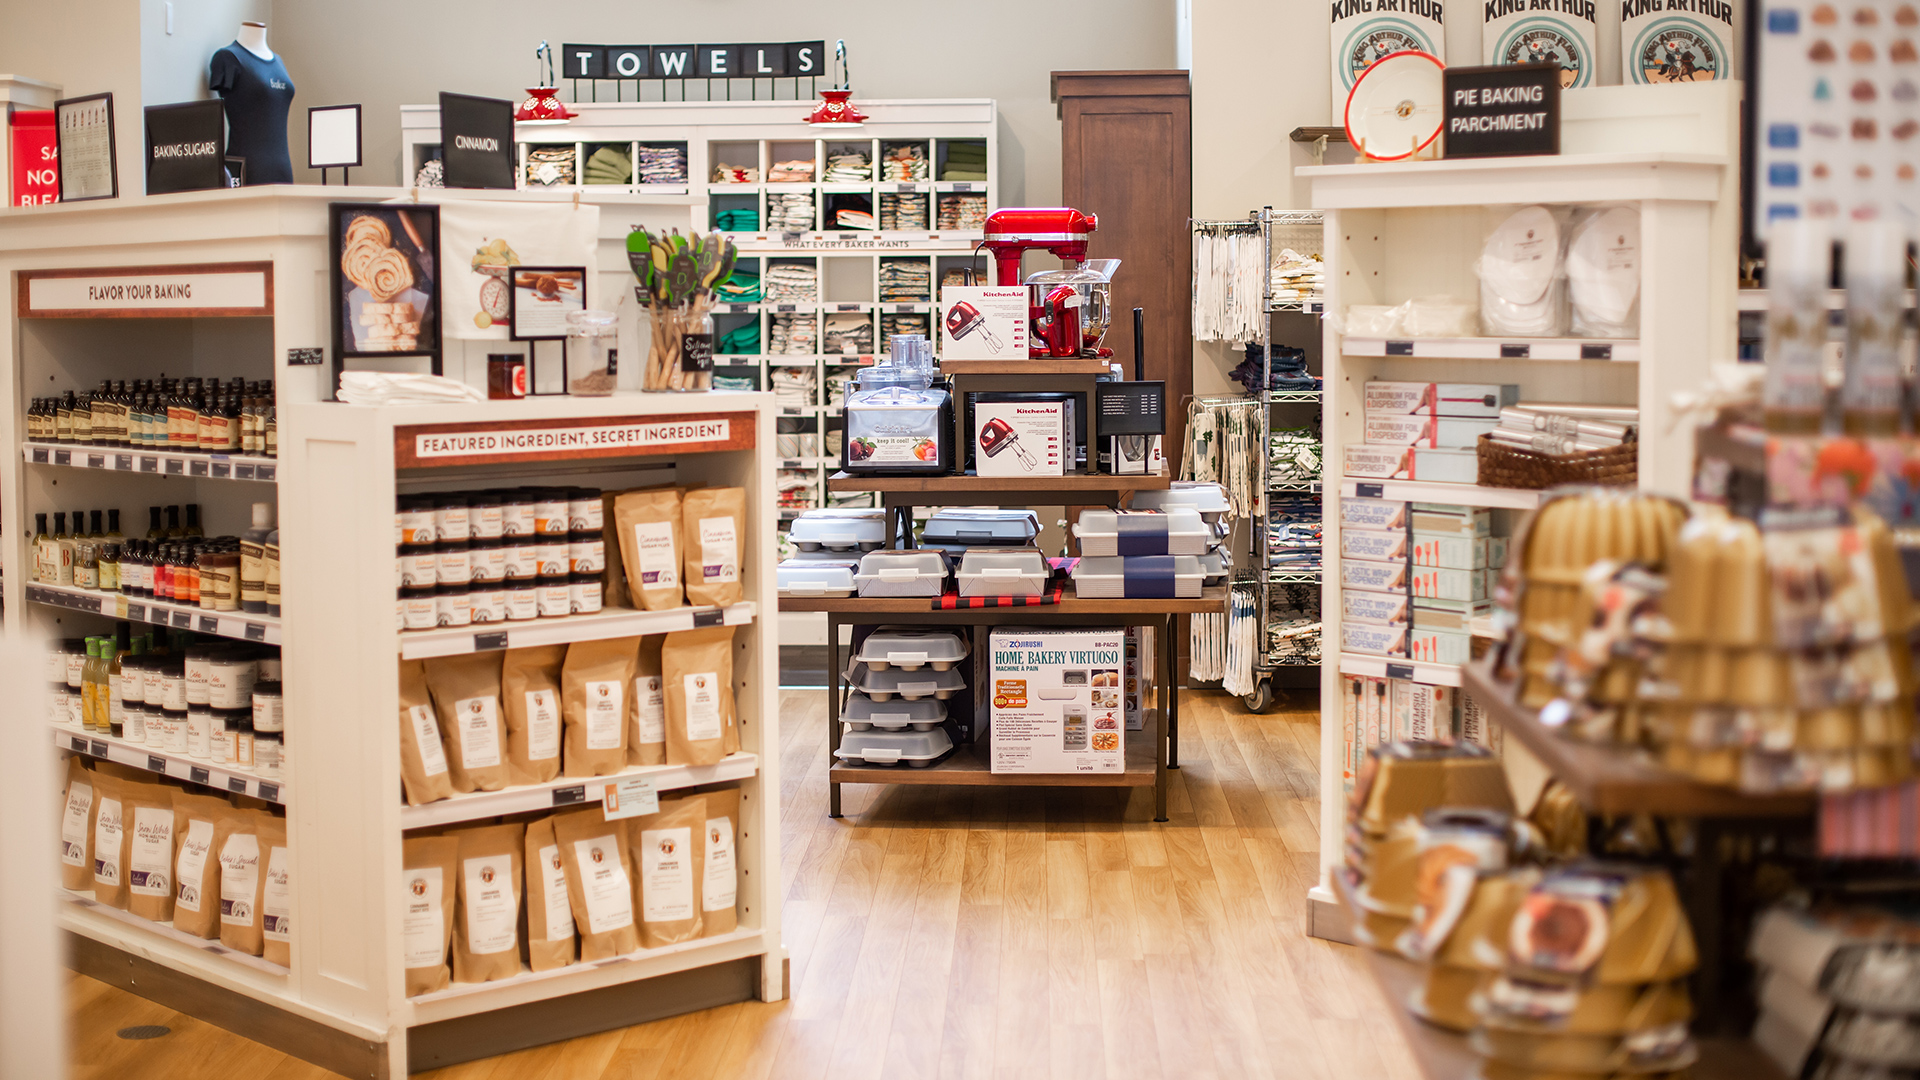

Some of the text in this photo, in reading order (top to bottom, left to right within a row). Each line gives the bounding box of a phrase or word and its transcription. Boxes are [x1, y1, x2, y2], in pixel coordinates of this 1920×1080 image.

[1332, 0, 1442, 25] KING ARTHUR
[1486, 0, 1596, 24] KING ARTHUR
[1622, 0, 1732, 26] KING ARTHUR
[1354, 41, 1369, 62] KING
[1369, 32, 1404, 45] ARTHUR
[1508, 31, 1578, 62] KING ARTHUR FLOUR
[1644, 31, 1714, 62] KING ARTHUR FLOUR
[575, 47, 814, 78] TOWELS
[1454, 86, 1544, 106] PIE BAKING
[1452, 112, 1547, 132] PARCHMENT
[154, 141, 216, 158] BAKING SUGARS
[455, 135, 498, 152] CINNAMON
[89, 284, 191, 300] FLAVOR YOUR BAKING
[1404, 392, 1419, 400] FOIL
[1372, 400, 1408, 408] DISPENSER
[1368, 422, 1419, 432] ALUMINUM FOIL
[424, 424, 722, 452] FEATURED INGREDIENT, SECRET INGREDIENT
[1372, 431, 1408, 440] DISPENSER
[1346, 454, 1397, 464] ALUMINUM FOIL
[1351, 463, 1386, 472] DISPENSER
[1341, 504, 1394, 516] PLASTIC WRAP
[1347, 514, 1385, 524] DISPENSER
[1343, 536, 1393, 548] PLASTIC WRAP
[63, 549, 70, 566] B
[1348, 546, 1385, 556] DISPENSER
[1343, 566, 1392, 578] PLASTIC WRAP
[1348, 576, 1384, 586] DISPENSER
[1345, 597, 1396, 610] PLASTIC WRAP
[1349, 608, 1388, 619] DISPENSER
[1343, 630, 1391, 642] PLASTIC WRAP
[1347, 640, 1384, 650] DISPENSER
[995, 650, 1118, 664] HOME BAKERY VIRTUOSO
